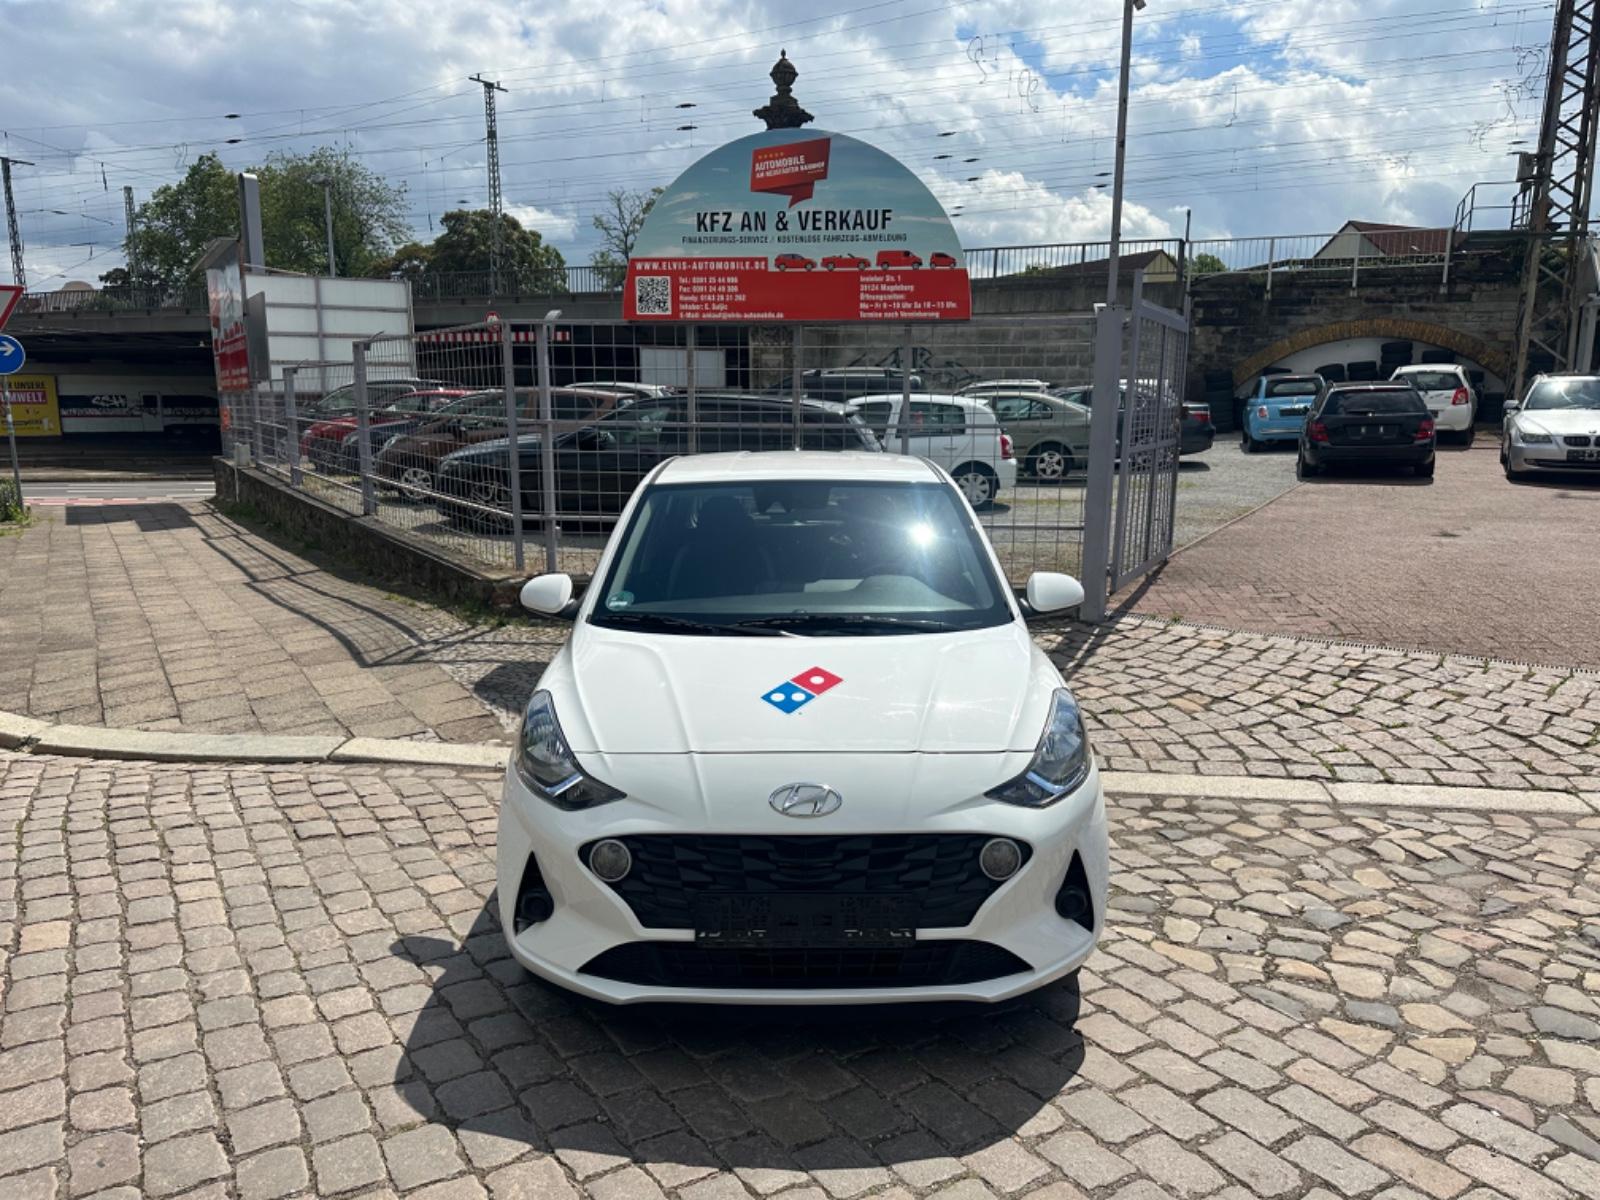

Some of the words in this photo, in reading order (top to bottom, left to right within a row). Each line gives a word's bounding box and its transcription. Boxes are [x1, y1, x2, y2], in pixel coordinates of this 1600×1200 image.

[755, 155, 805, 172] AUTOMOBILE
[696, 212, 732, 232] KFZ
[741, 211, 766, 232] AN
[775, 211, 789, 232] &
[798, 209, 893, 231] VERKAUF
[682, 236, 768, 244] FINANZIERUNGS-SERVICE
[777, 234, 821, 243] KOSTENLOSE
[823, 233, 907, 242] FAHRZEUG-ABMELDUNG
[635, 261, 766, 271] WWW.ELVIS-AUTOMOBILE.DE
[880, 284, 914, 292] Magdeburg
